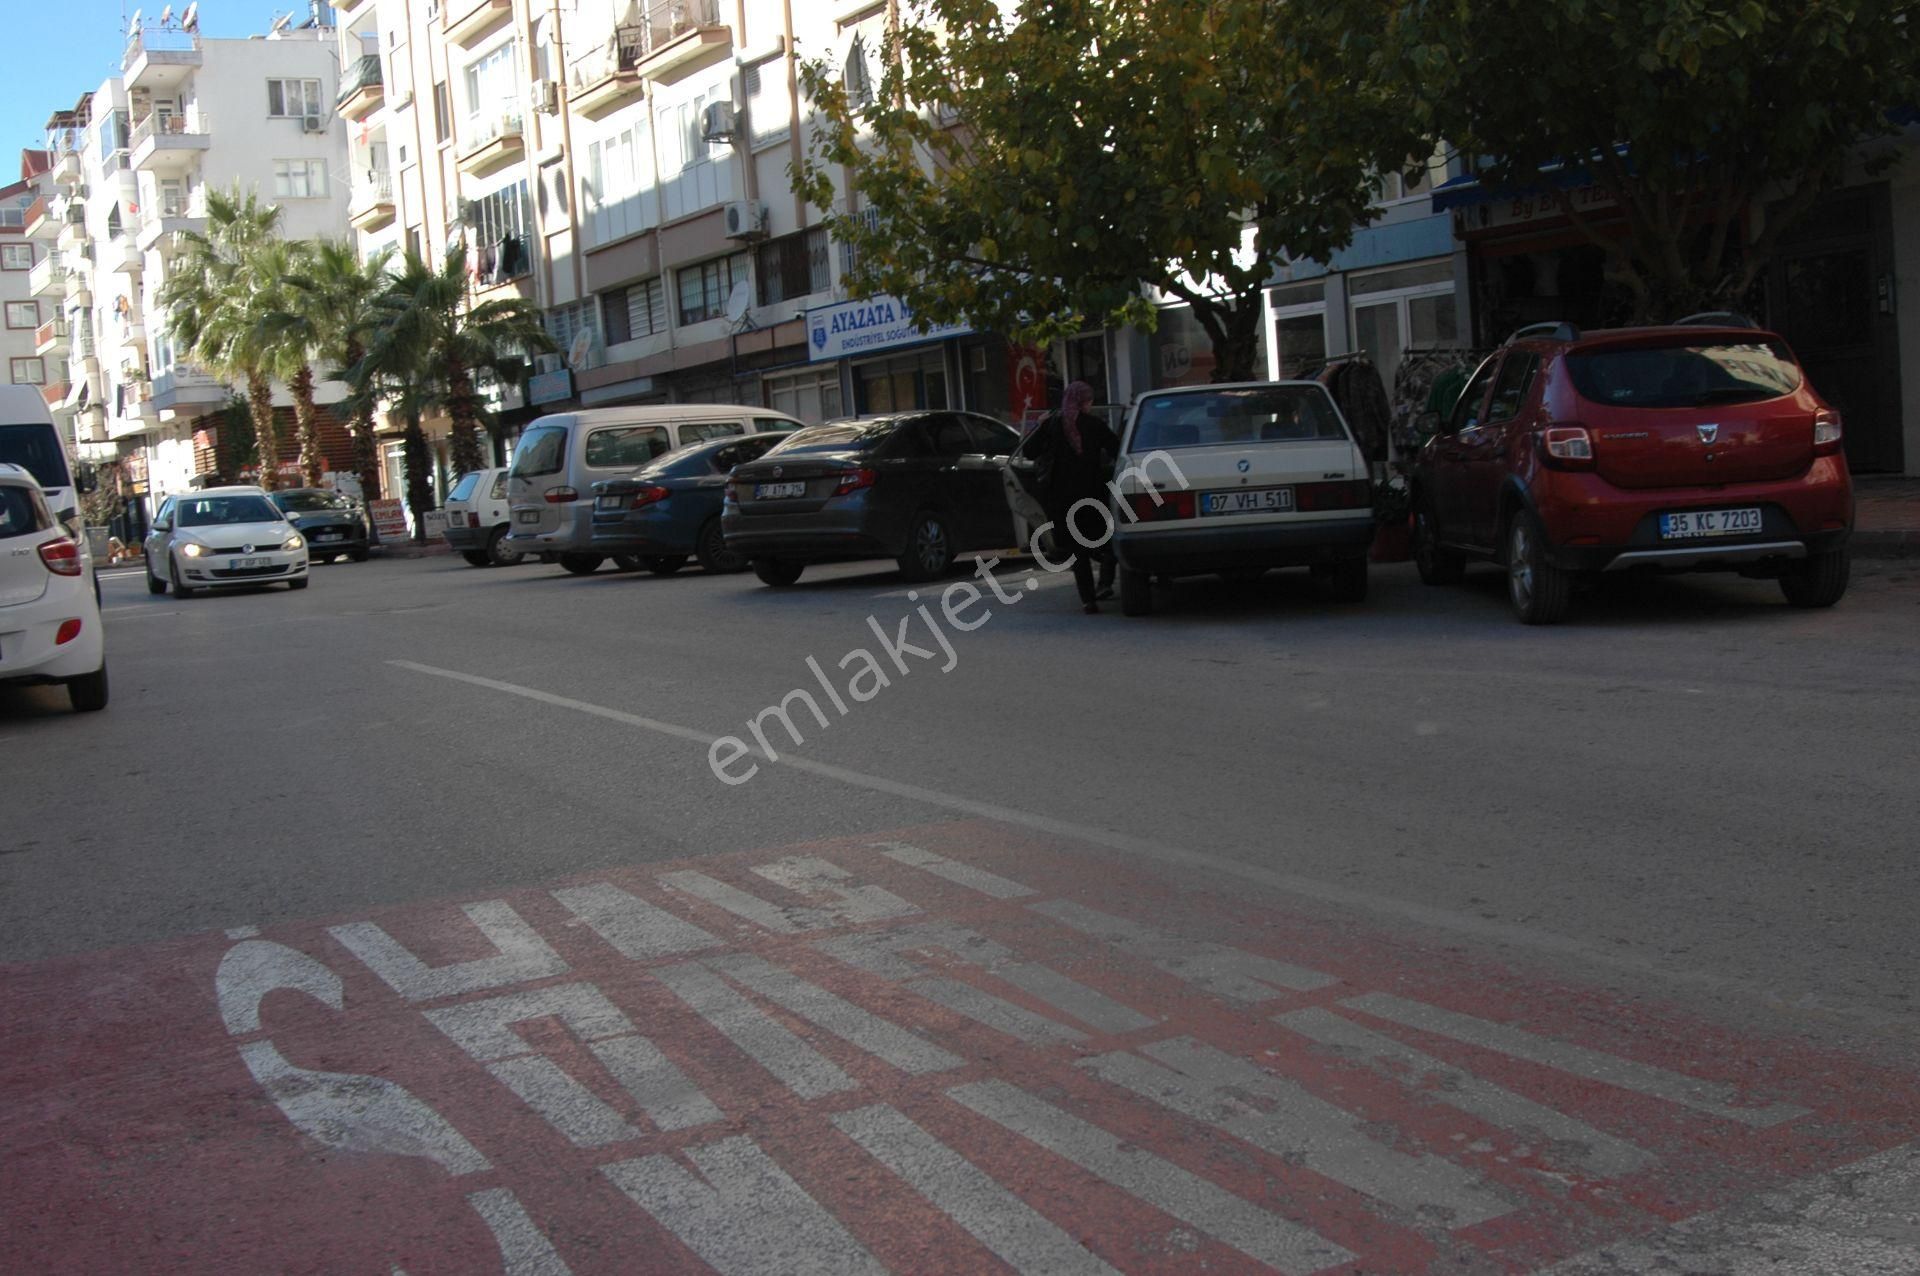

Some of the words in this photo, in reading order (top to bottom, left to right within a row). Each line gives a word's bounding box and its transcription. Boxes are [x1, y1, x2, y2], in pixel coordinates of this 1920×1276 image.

[830, 303, 895, 334] AYAZATA
[841, 331, 885, 350] ENDÜSTRİYEL
[1210, 496, 1228, 510] 07
[1236, 494, 1259, 509] VH
[1265, 491, 1289, 507] 511
[1670, 515, 1688, 532] 35
[1696, 513, 1715, 530] KC
[1721, 510, 1759, 529] 7203
